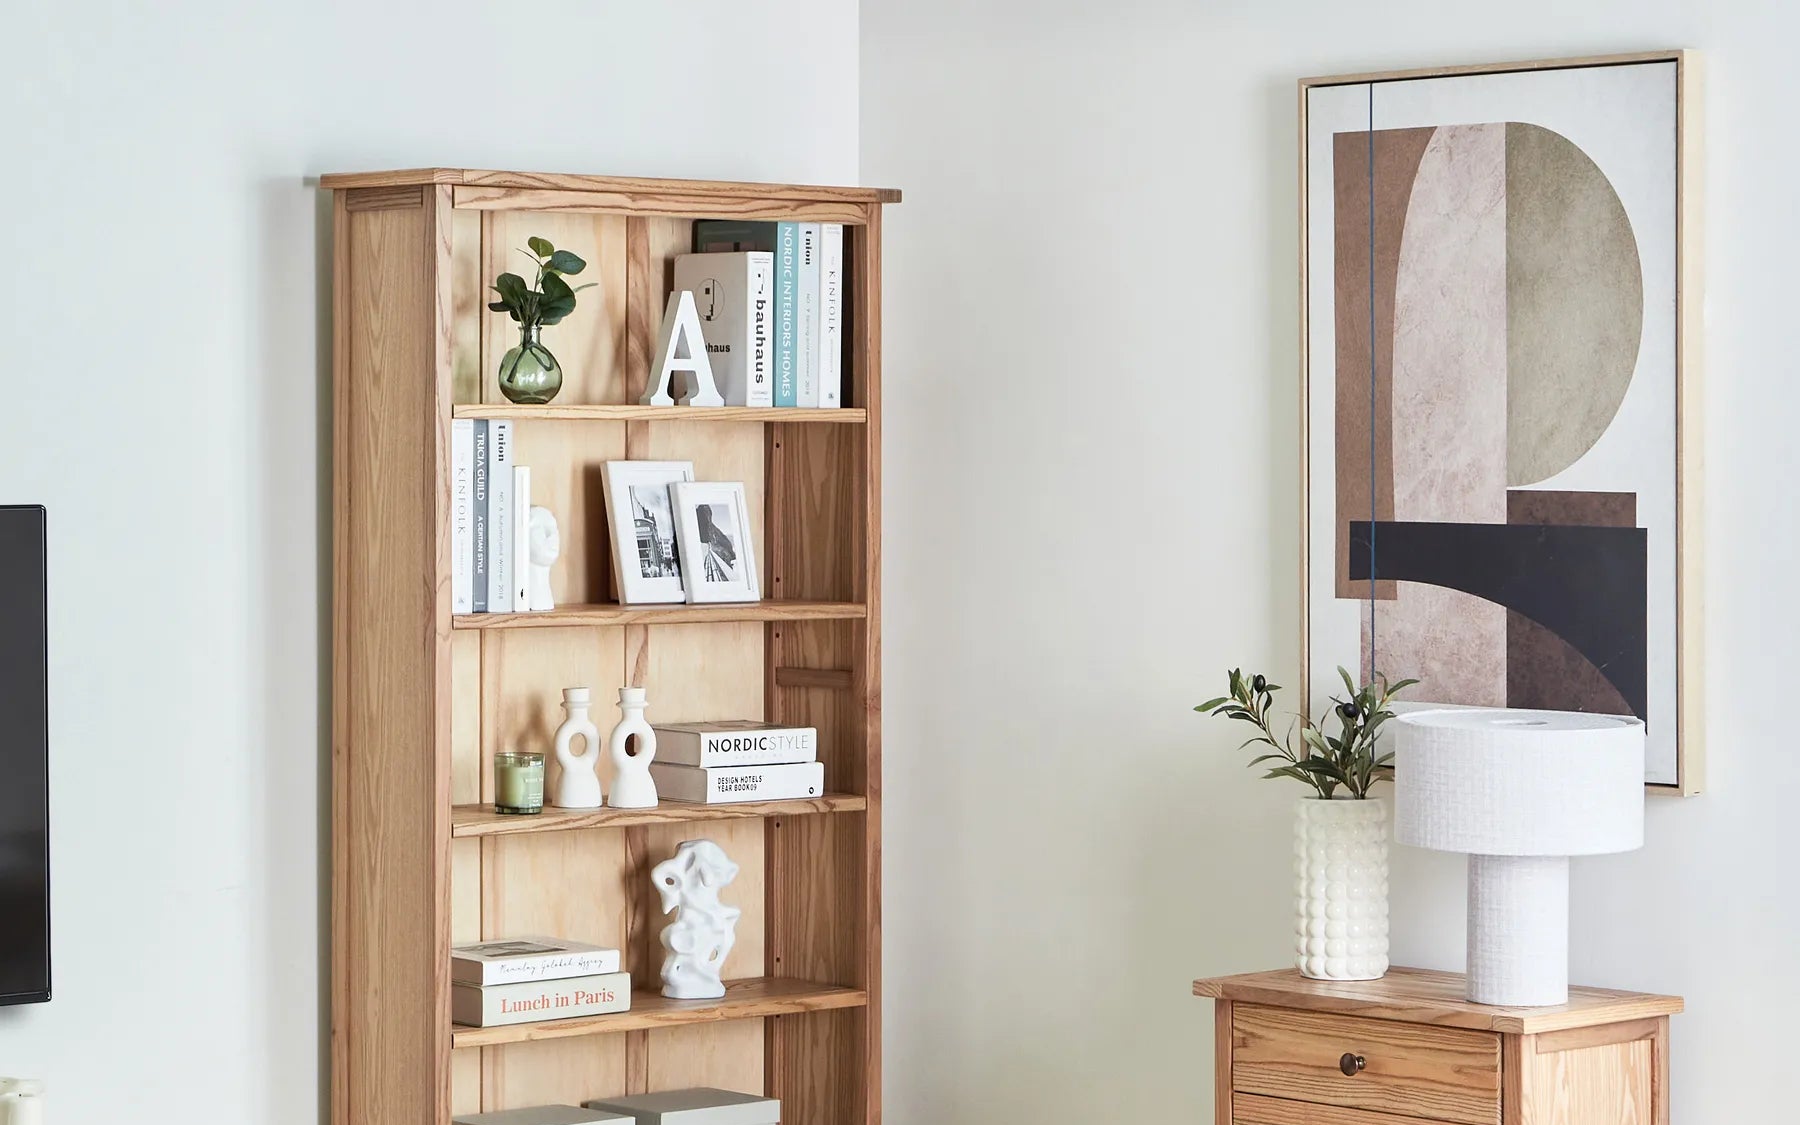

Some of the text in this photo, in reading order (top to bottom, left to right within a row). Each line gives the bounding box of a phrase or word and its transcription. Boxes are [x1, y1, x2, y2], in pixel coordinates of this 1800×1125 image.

[781, 227, 793, 397] NORDIC INTERIORS HOMES
[828, 270, 836, 333] KINFOLK
[647, 290, 725, 406] A
[705, 342, 731, 353] haus
[755, 299, 767, 383] bauhaus
[477, 432, 485, 501] TRICIA GUILD
[498, 425, 506, 461] Union
[457, 467, 466, 534] KINFOLK
[717, 775, 763, 785] DESIGN HOTELS
[717, 784, 733, 793] YEAR
[501, 988, 615, 1014] Lunch in Paris
